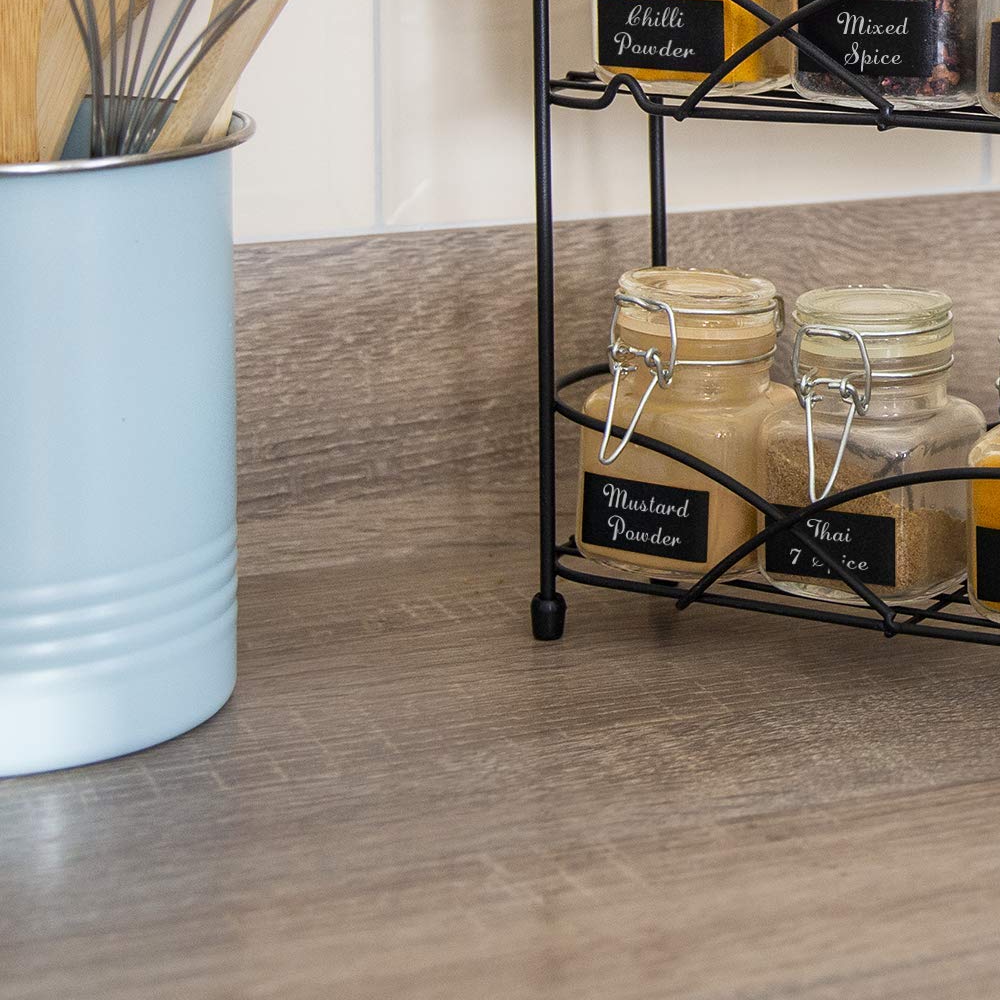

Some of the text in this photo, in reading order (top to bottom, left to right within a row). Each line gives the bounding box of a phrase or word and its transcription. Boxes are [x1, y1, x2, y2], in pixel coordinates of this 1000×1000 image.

[626, 4, 684, 28] Chilli
[837, 12, 909, 35] Mixed
[614, 32, 695, 59] Powder
[844, 42, 902, 73] Spice
[603, 483, 690, 518] Mustard
[607, 515, 682, 547] Powder
[806, 518, 852, 543] Thai
[789, 548, 802, 565] 7
